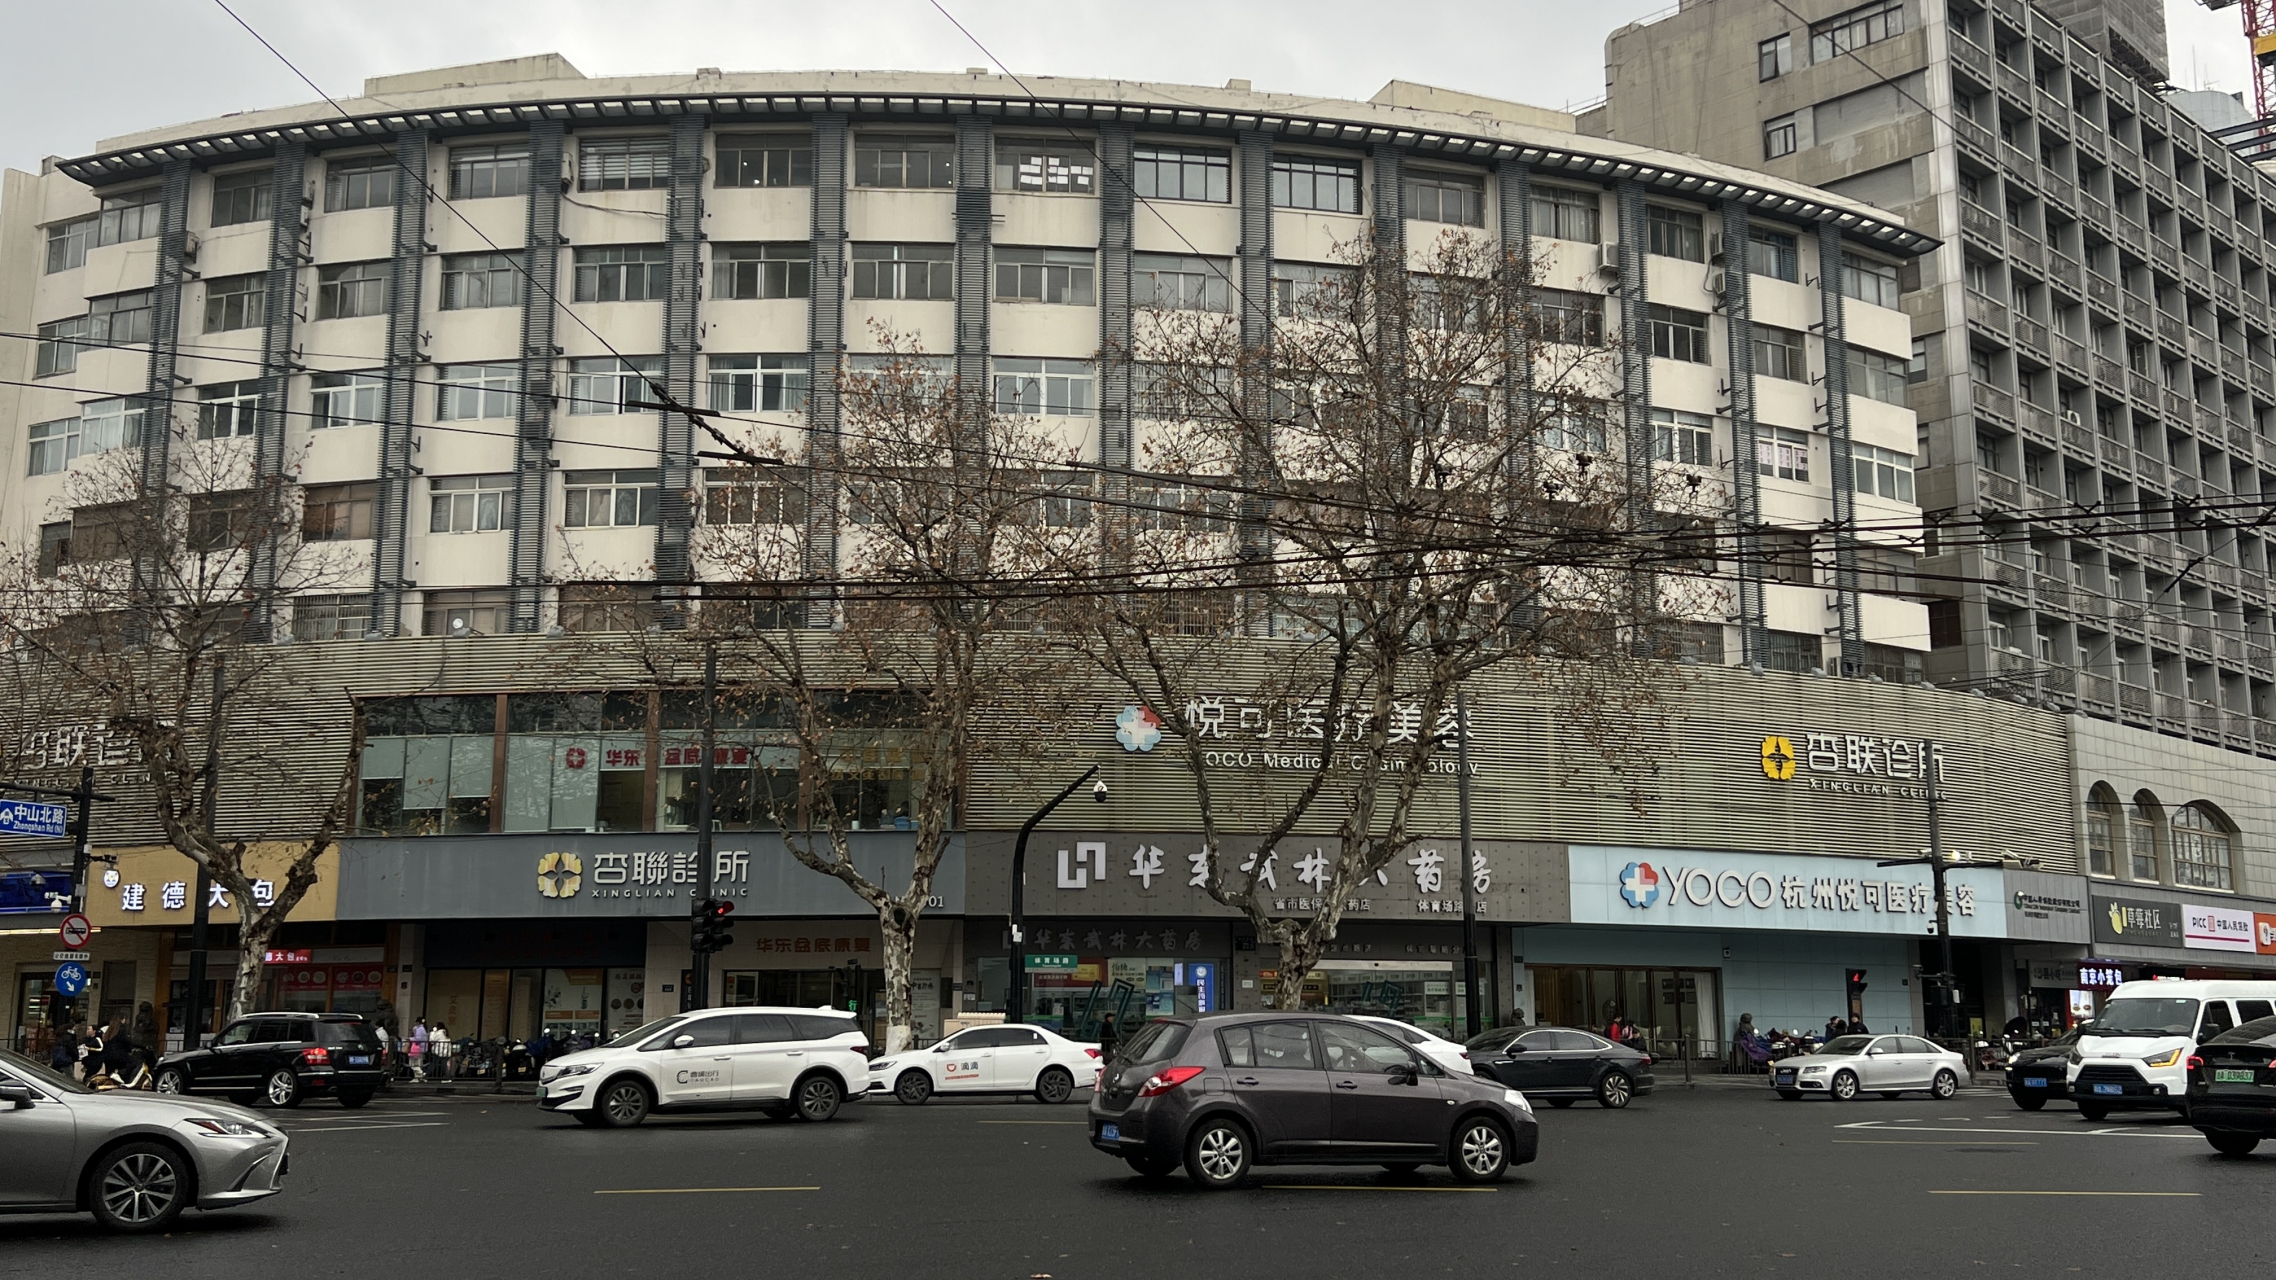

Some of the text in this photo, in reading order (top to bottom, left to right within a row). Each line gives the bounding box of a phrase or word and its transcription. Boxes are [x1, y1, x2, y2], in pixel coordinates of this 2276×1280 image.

[1205, 751, 1252, 767] OCO
[1806, 732, 1946, 782] 杏联诊所
[14, 803, 63, 824] 中山北路
[13, 820, 46, 833] Zhongshan
[46, 824, 54, 833] Rd
[594, 851, 750, 885] 杏聯診所
[591, 888, 748, 898] XINGLIAN CINIC
[1663, 866, 1776, 908] YOCO
[121, 880, 275, 912] 建德大包
[1275, 897, 1371, 912] 省市医保药店
[1418, 899, 1487, 913] 体育场路店
[2127, 907, 2162, 930] 草莓社区
[2192, 916, 2249, 932] PICC 中国人民保险
[756, 937, 871, 953] 华东盆底康复
[2080, 967, 2122, 985] 南京小笼包
